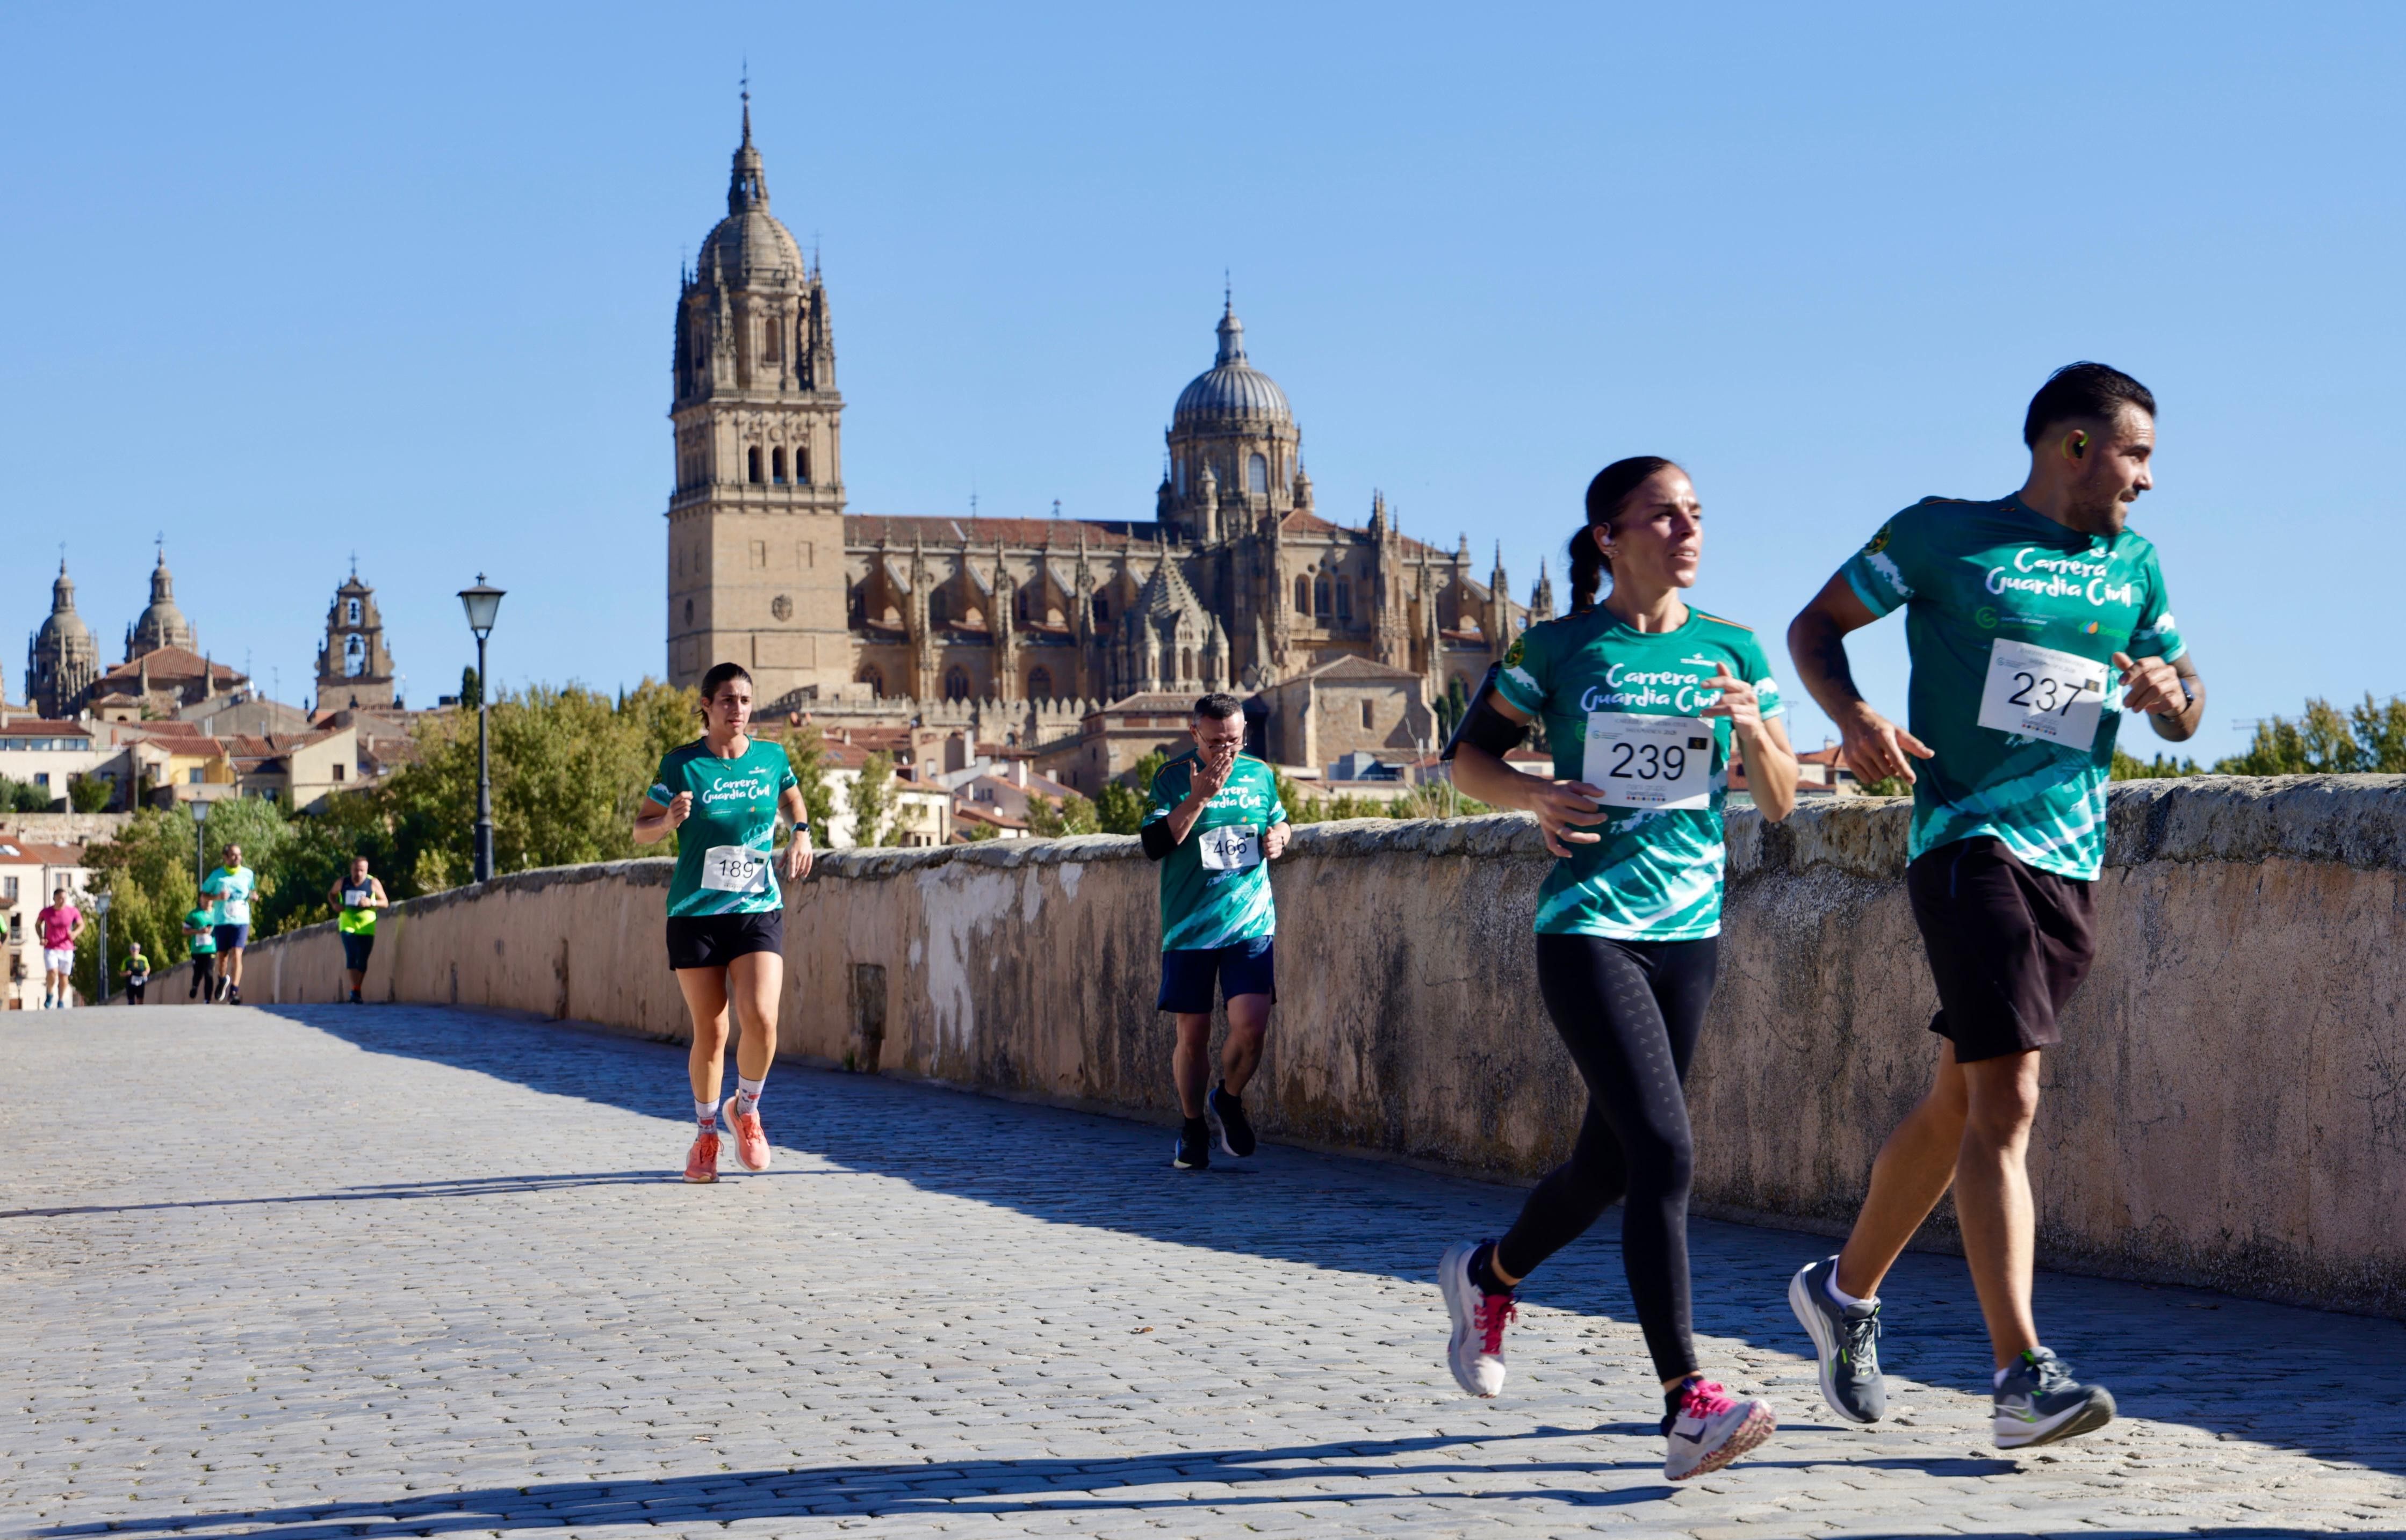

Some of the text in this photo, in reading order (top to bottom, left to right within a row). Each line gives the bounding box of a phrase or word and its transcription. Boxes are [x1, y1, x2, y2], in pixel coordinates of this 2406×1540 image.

[2013, 547, 2107, 577] Carrera
[1985, 566, 2131, 608] Guardia Civil
[1605, 663, 1699, 688] Carrera
[1580, 685, 1670, 713] Guardia
[2008, 671, 2084, 717] 237
[1609, 742, 1685, 780] 239
[702, 784, 770, 804] Guardia Civil
[713, 777, 759, 792] Carrera
[1219, 786, 1249, 796] rrera
[1206, 794, 1261, 809] ardia Civil
[1213, 837, 1247, 857] 466
[718, 859, 754, 879] 189
